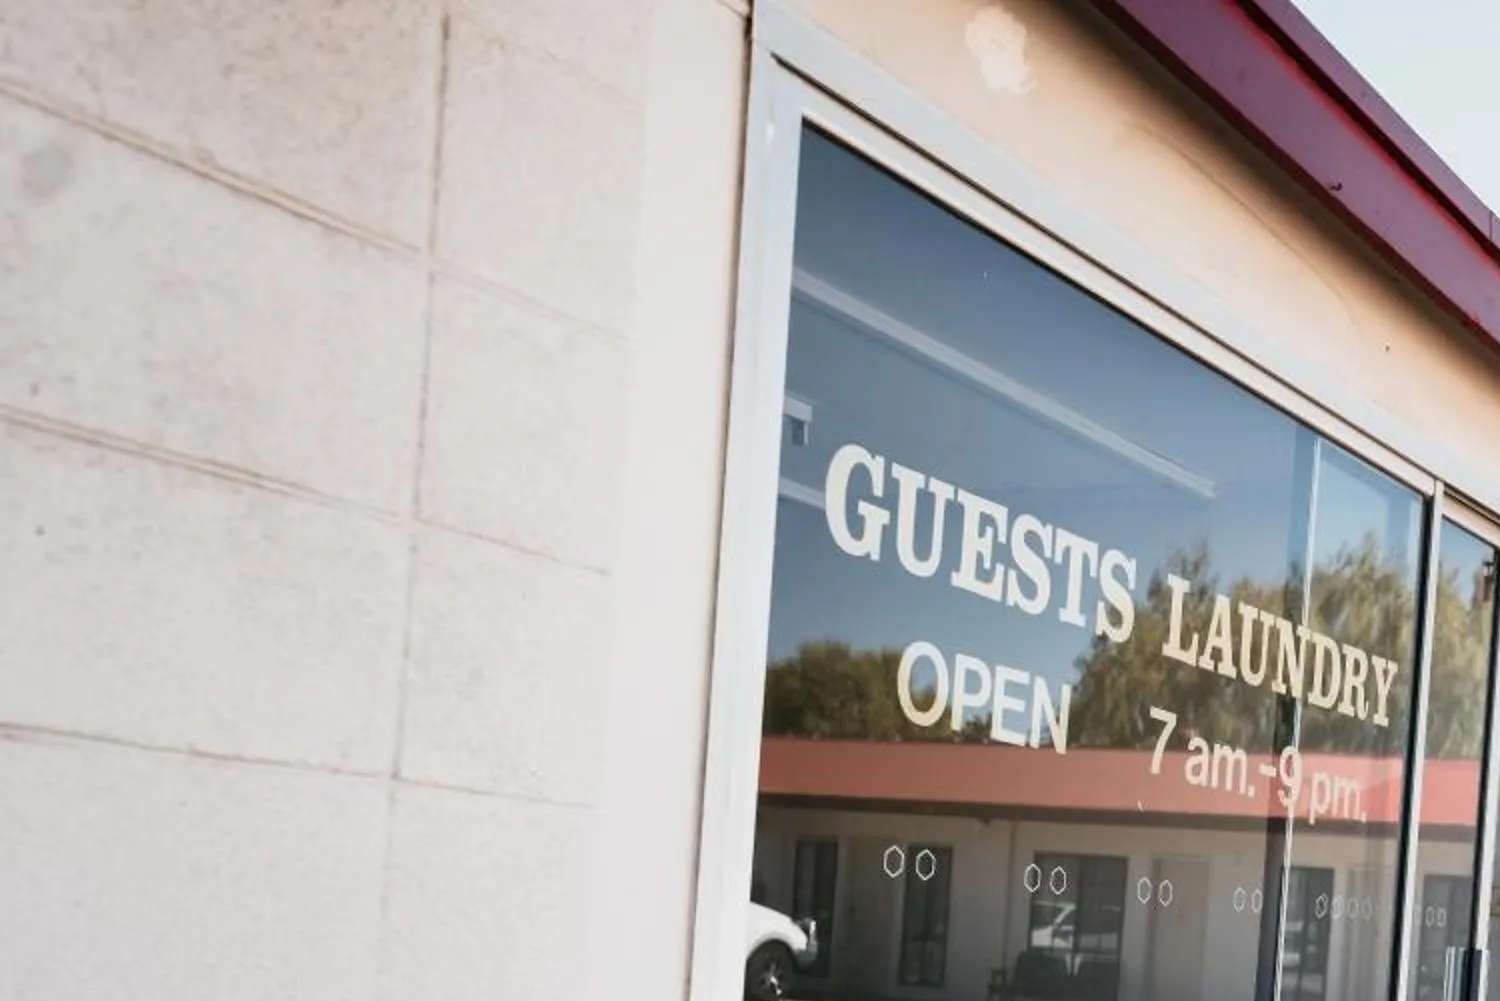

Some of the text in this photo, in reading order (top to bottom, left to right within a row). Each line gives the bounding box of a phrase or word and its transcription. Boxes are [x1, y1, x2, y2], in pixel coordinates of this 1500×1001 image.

[825, 444, 1398, 727] GUESTS LAUNDRY
[897, 641, 1072, 755] OPEN
[1149, 706, 1177, 775] 7
